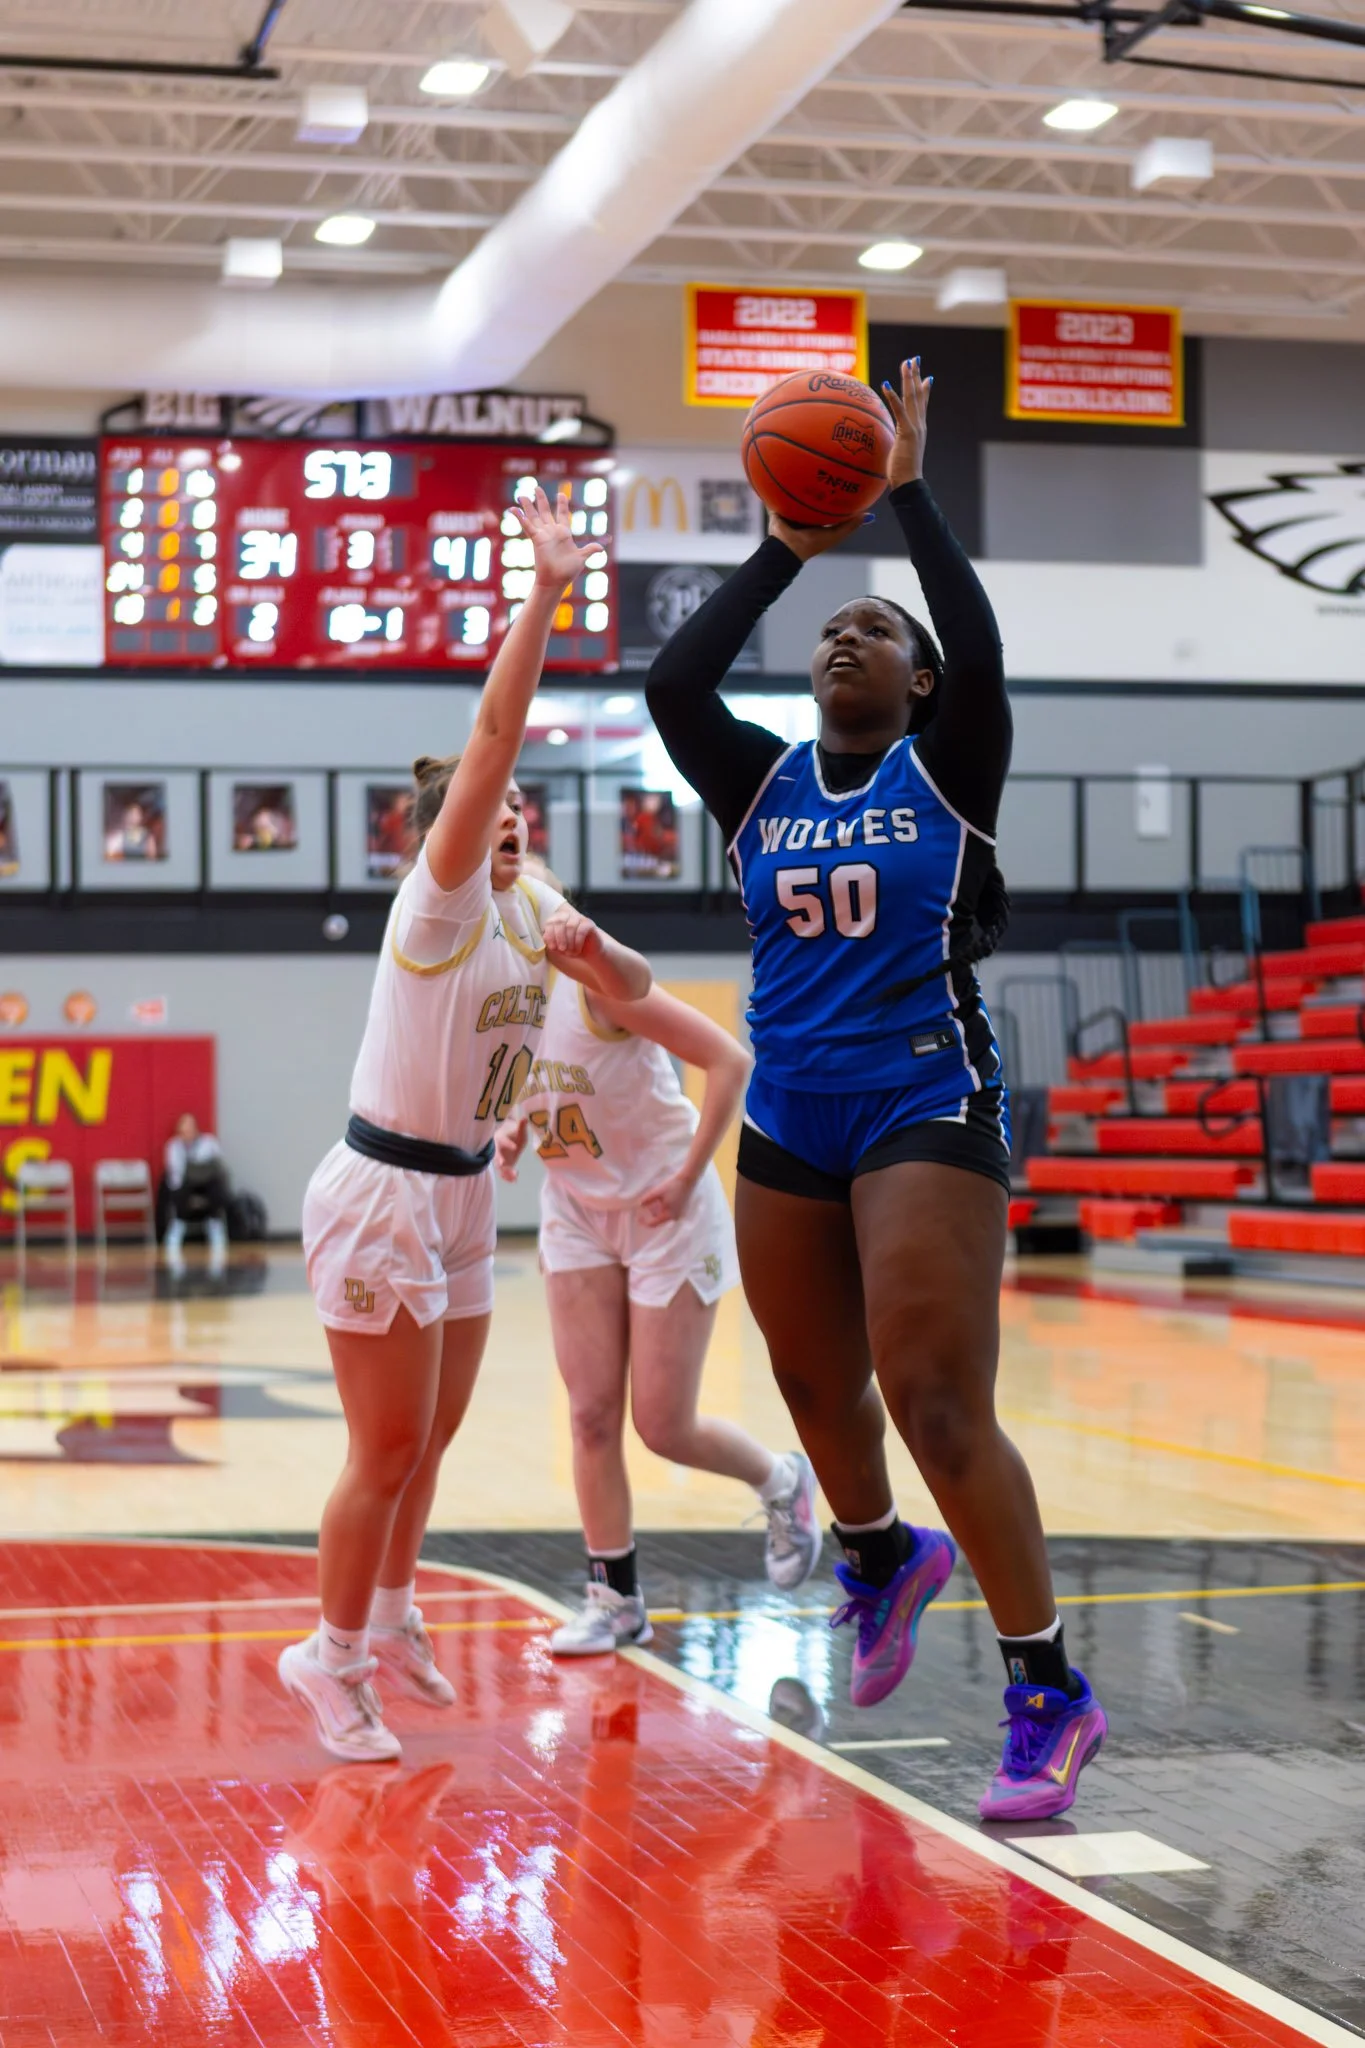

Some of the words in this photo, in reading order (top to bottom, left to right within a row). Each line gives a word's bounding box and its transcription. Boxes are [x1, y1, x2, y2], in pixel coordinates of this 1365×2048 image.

[734, 296, 817, 329] 2022
[1055, 311, 1135, 345] 2023
[145, 390, 220, 425] BIG
[388, 394, 582, 436] WALNUT
[826, 475, 860, 494] NFHS
[239, 530, 298, 579] 34
[433, 536, 492, 581] 41
[757, 807, 920, 855] WOLVES
[775, 861, 878, 939] 50
[529, 1102, 604, 1159] 24
